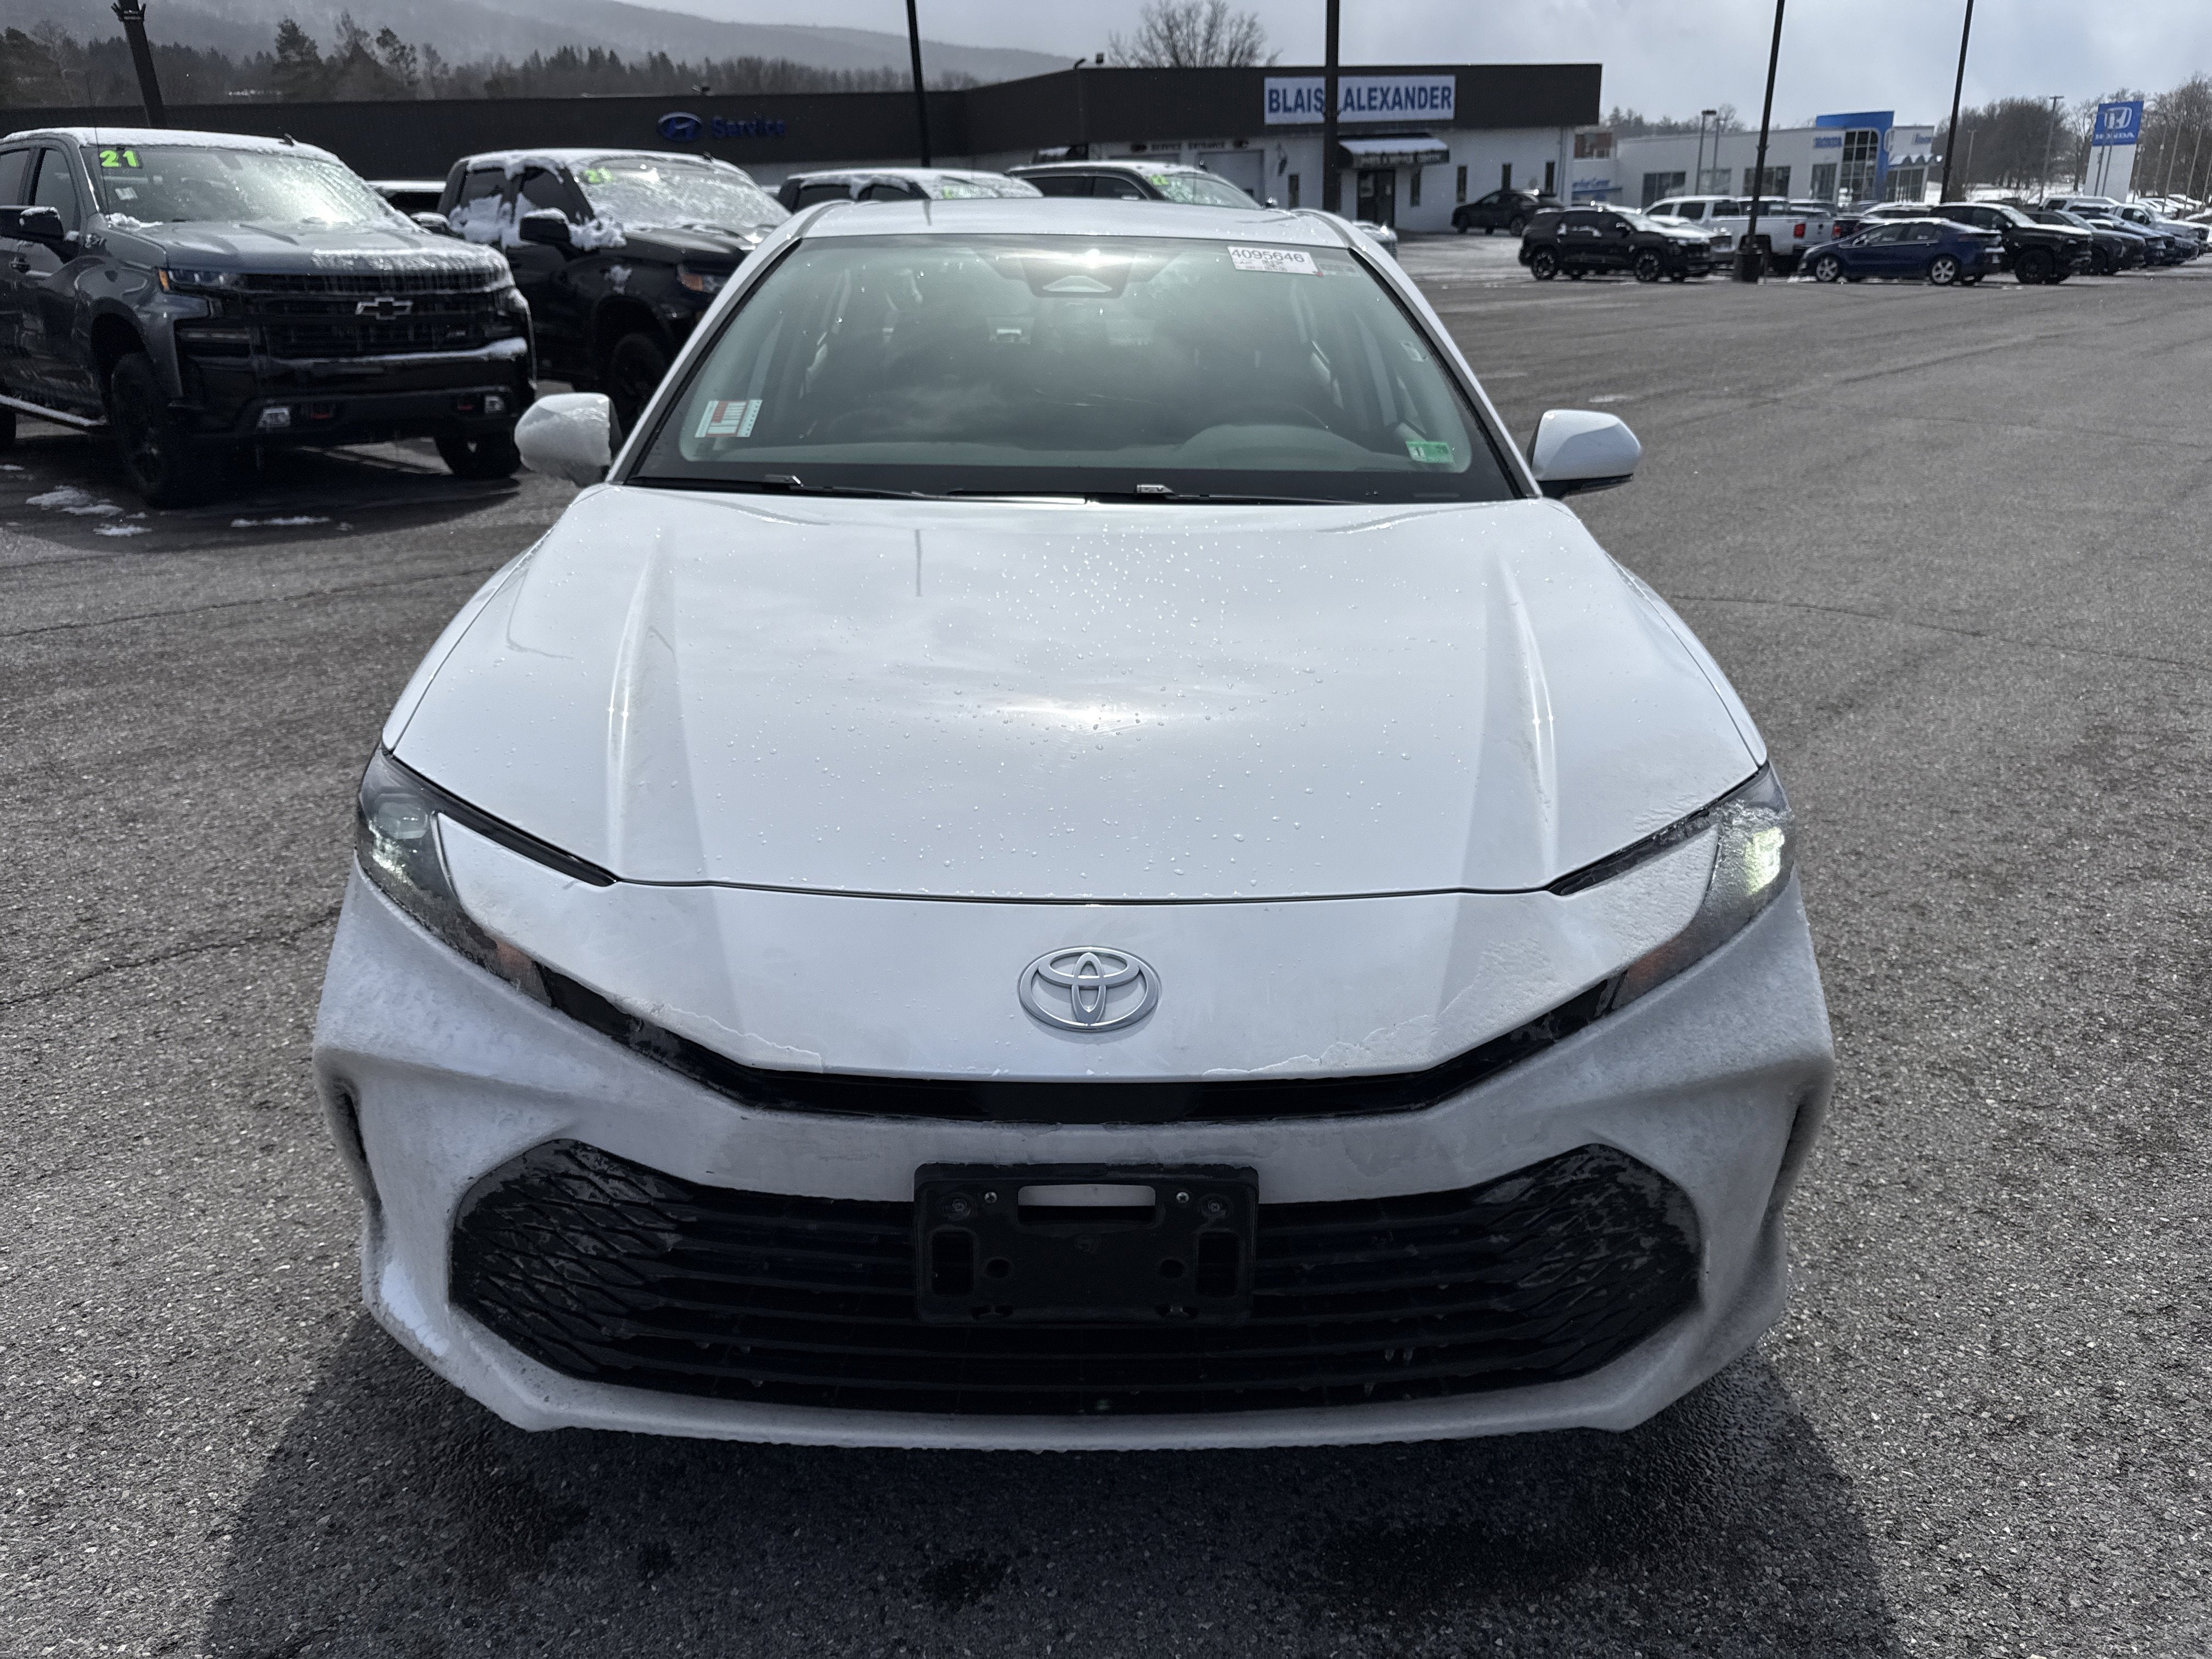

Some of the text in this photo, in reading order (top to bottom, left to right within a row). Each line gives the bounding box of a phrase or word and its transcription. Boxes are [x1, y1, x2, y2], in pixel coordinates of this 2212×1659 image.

[1344, 86, 1452, 112] ALEXANDER
[99, 150, 139, 167] 21
[1232, 249, 1305, 262] 4095646
